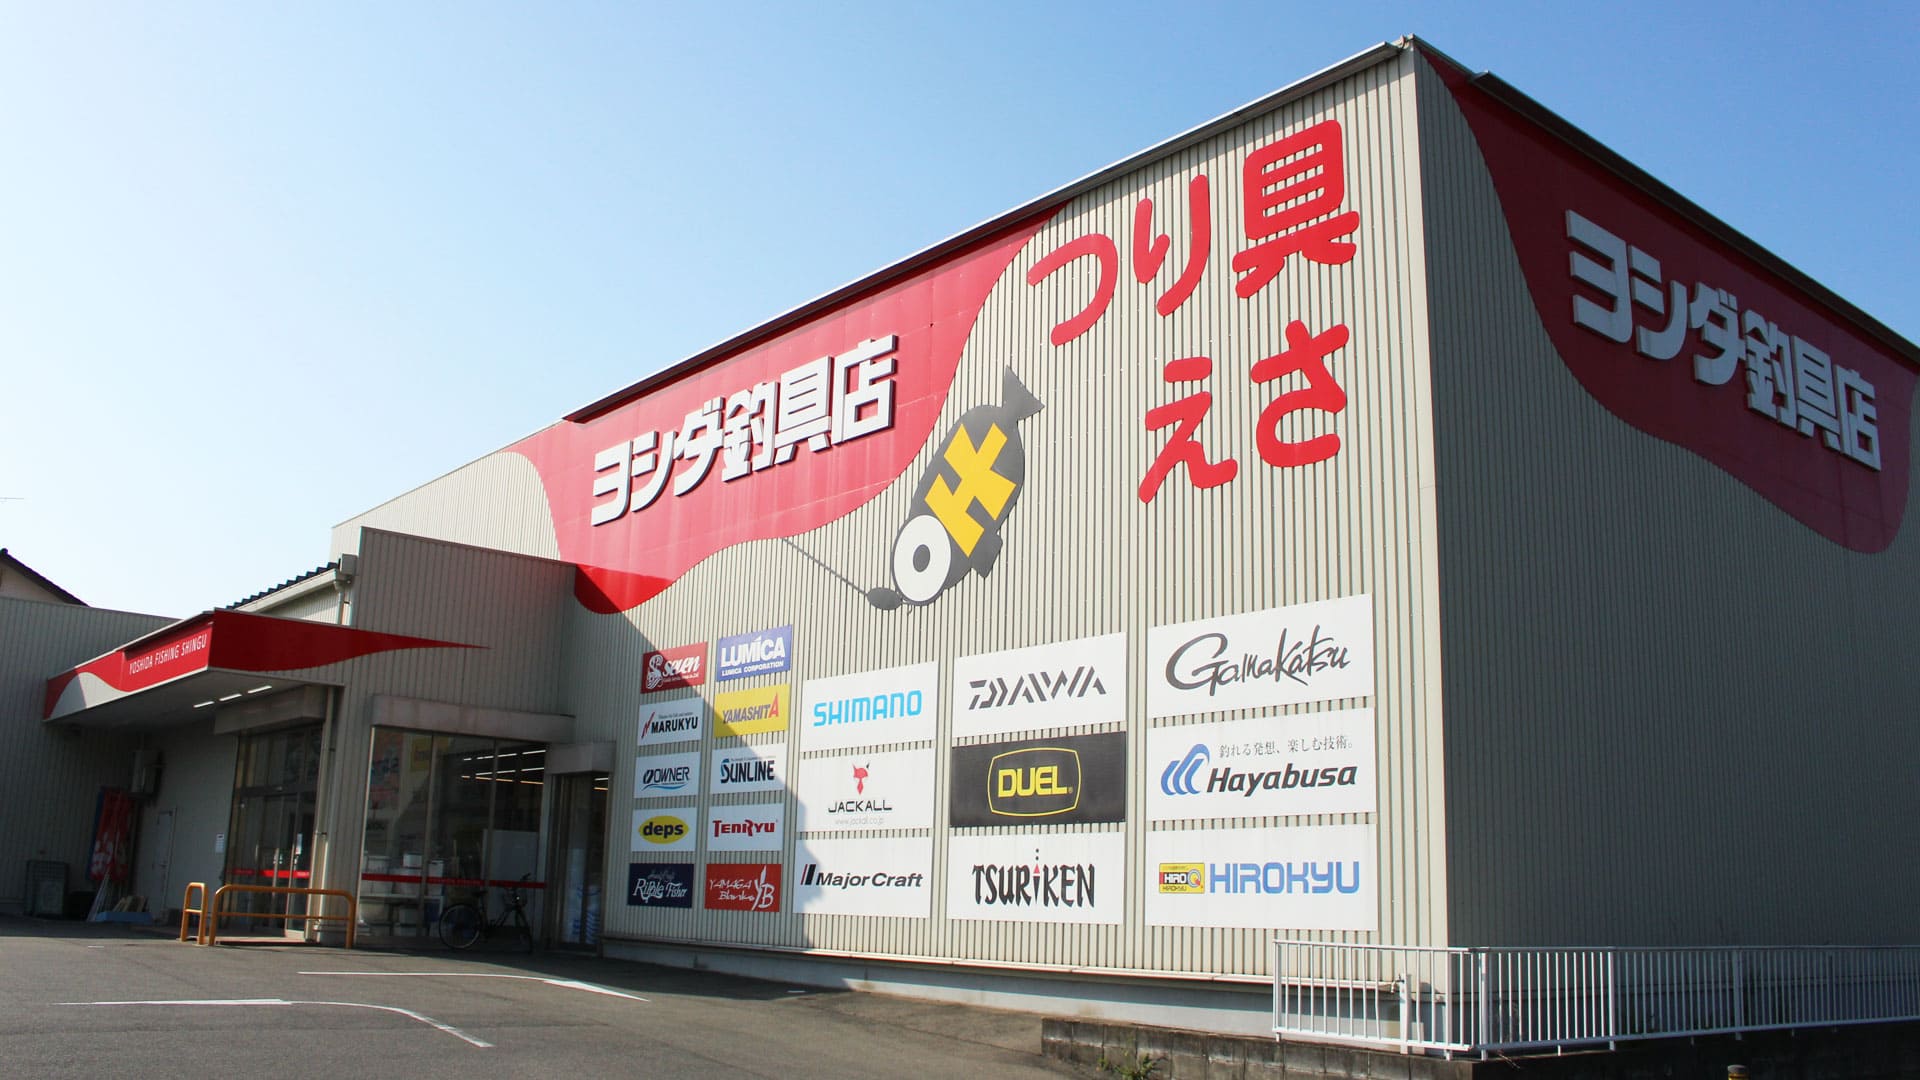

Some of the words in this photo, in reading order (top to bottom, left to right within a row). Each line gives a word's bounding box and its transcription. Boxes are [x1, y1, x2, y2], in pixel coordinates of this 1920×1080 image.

[1565, 209, 1882, 472] ヨシダ釣具店
[1138, 320, 1350, 503] えさ
[591, 334, 898, 527] ヨシダ釣具店
[129, 655, 153, 676] YOSHIDA
[155, 644, 180, 666] FISHING
[181, 633, 208, 656] SHINGU
[722, 668, 742, 676] LUMICA
[744, 660, 784, 673] CORPORATION
[968, 665, 1107, 710] DAIWA
[651, 716, 698, 733] MARUKYU
[723, 692, 779, 724] YAMASHITA
[813, 689, 922, 727] SHIMANO
[720, 758, 775, 784] SUNLINE
[998, 766, 1067, 797] DUEL
[1207, 762, 1358, 797] Hayabusa
[828, 799, 892, 813] JACKALL
[643, 822, 684, 838] deps
[1209, 861, 1360, 894] HIROKYU
